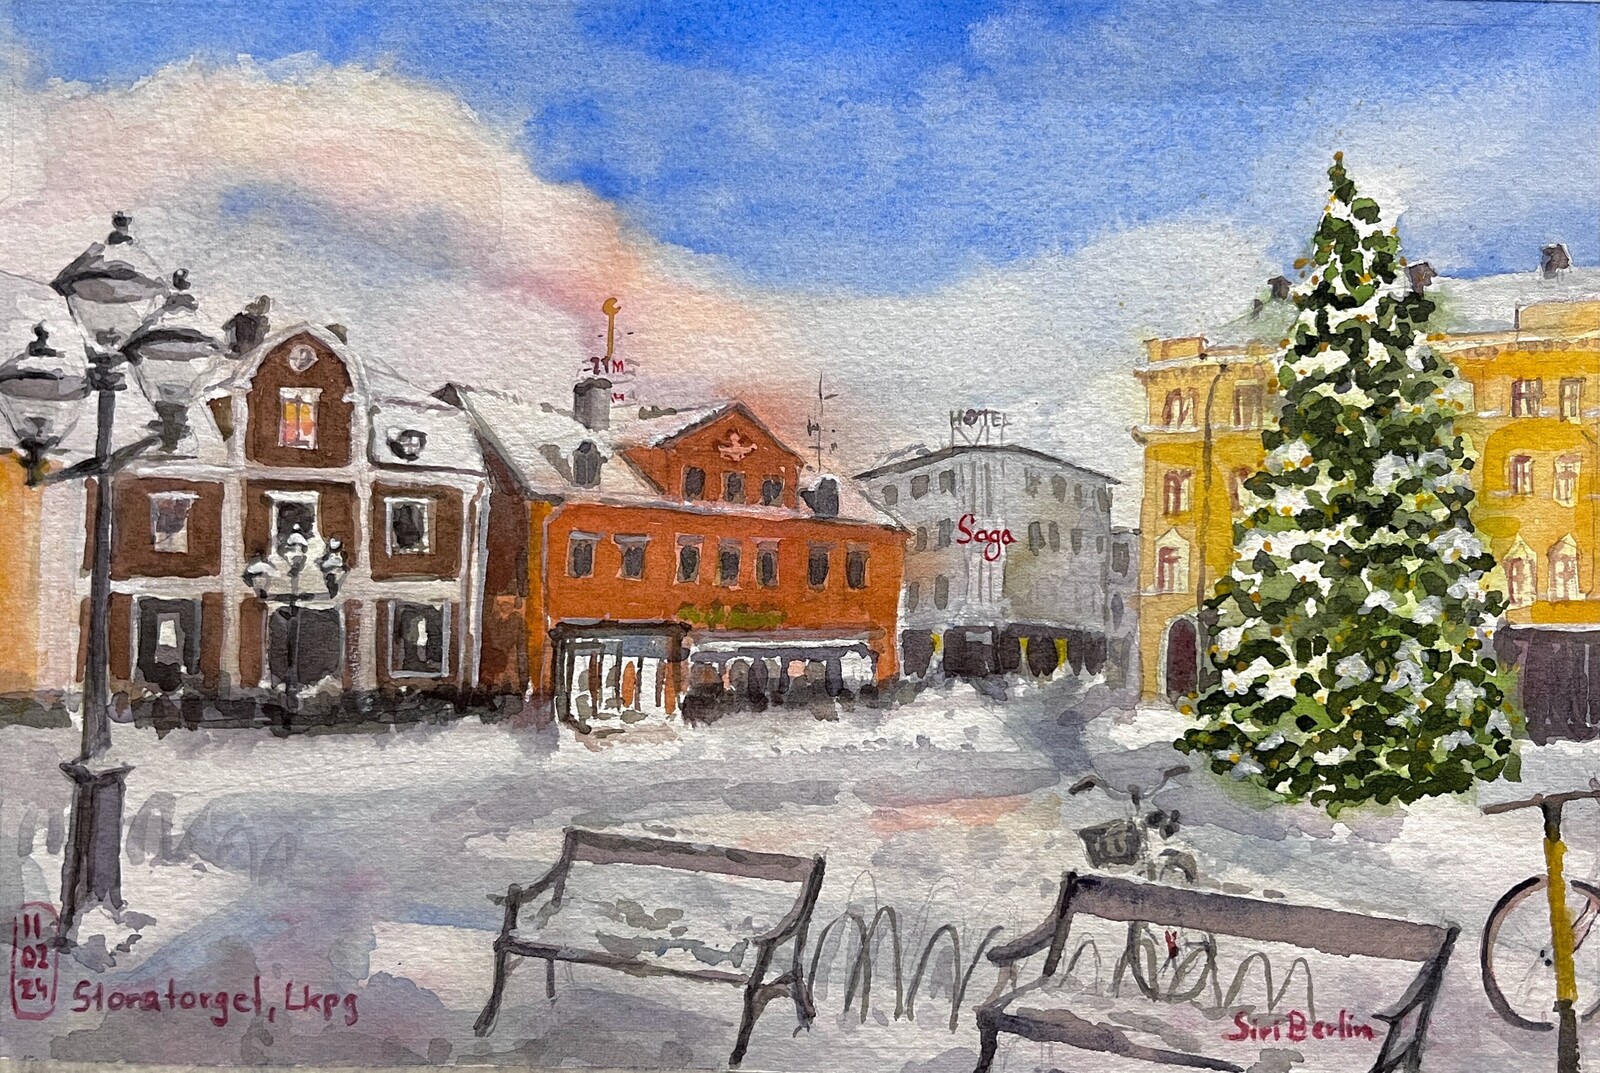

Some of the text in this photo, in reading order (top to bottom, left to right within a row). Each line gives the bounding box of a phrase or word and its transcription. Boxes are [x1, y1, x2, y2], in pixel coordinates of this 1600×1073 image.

[950, 408, 1012, 428] HOTEL
[956, 513, 1018, 562] Saga
[21, 943, 49, 969] 02
[17, 977, 48, 1001] 24
[285, 981, 359, 1027] Lkpg
